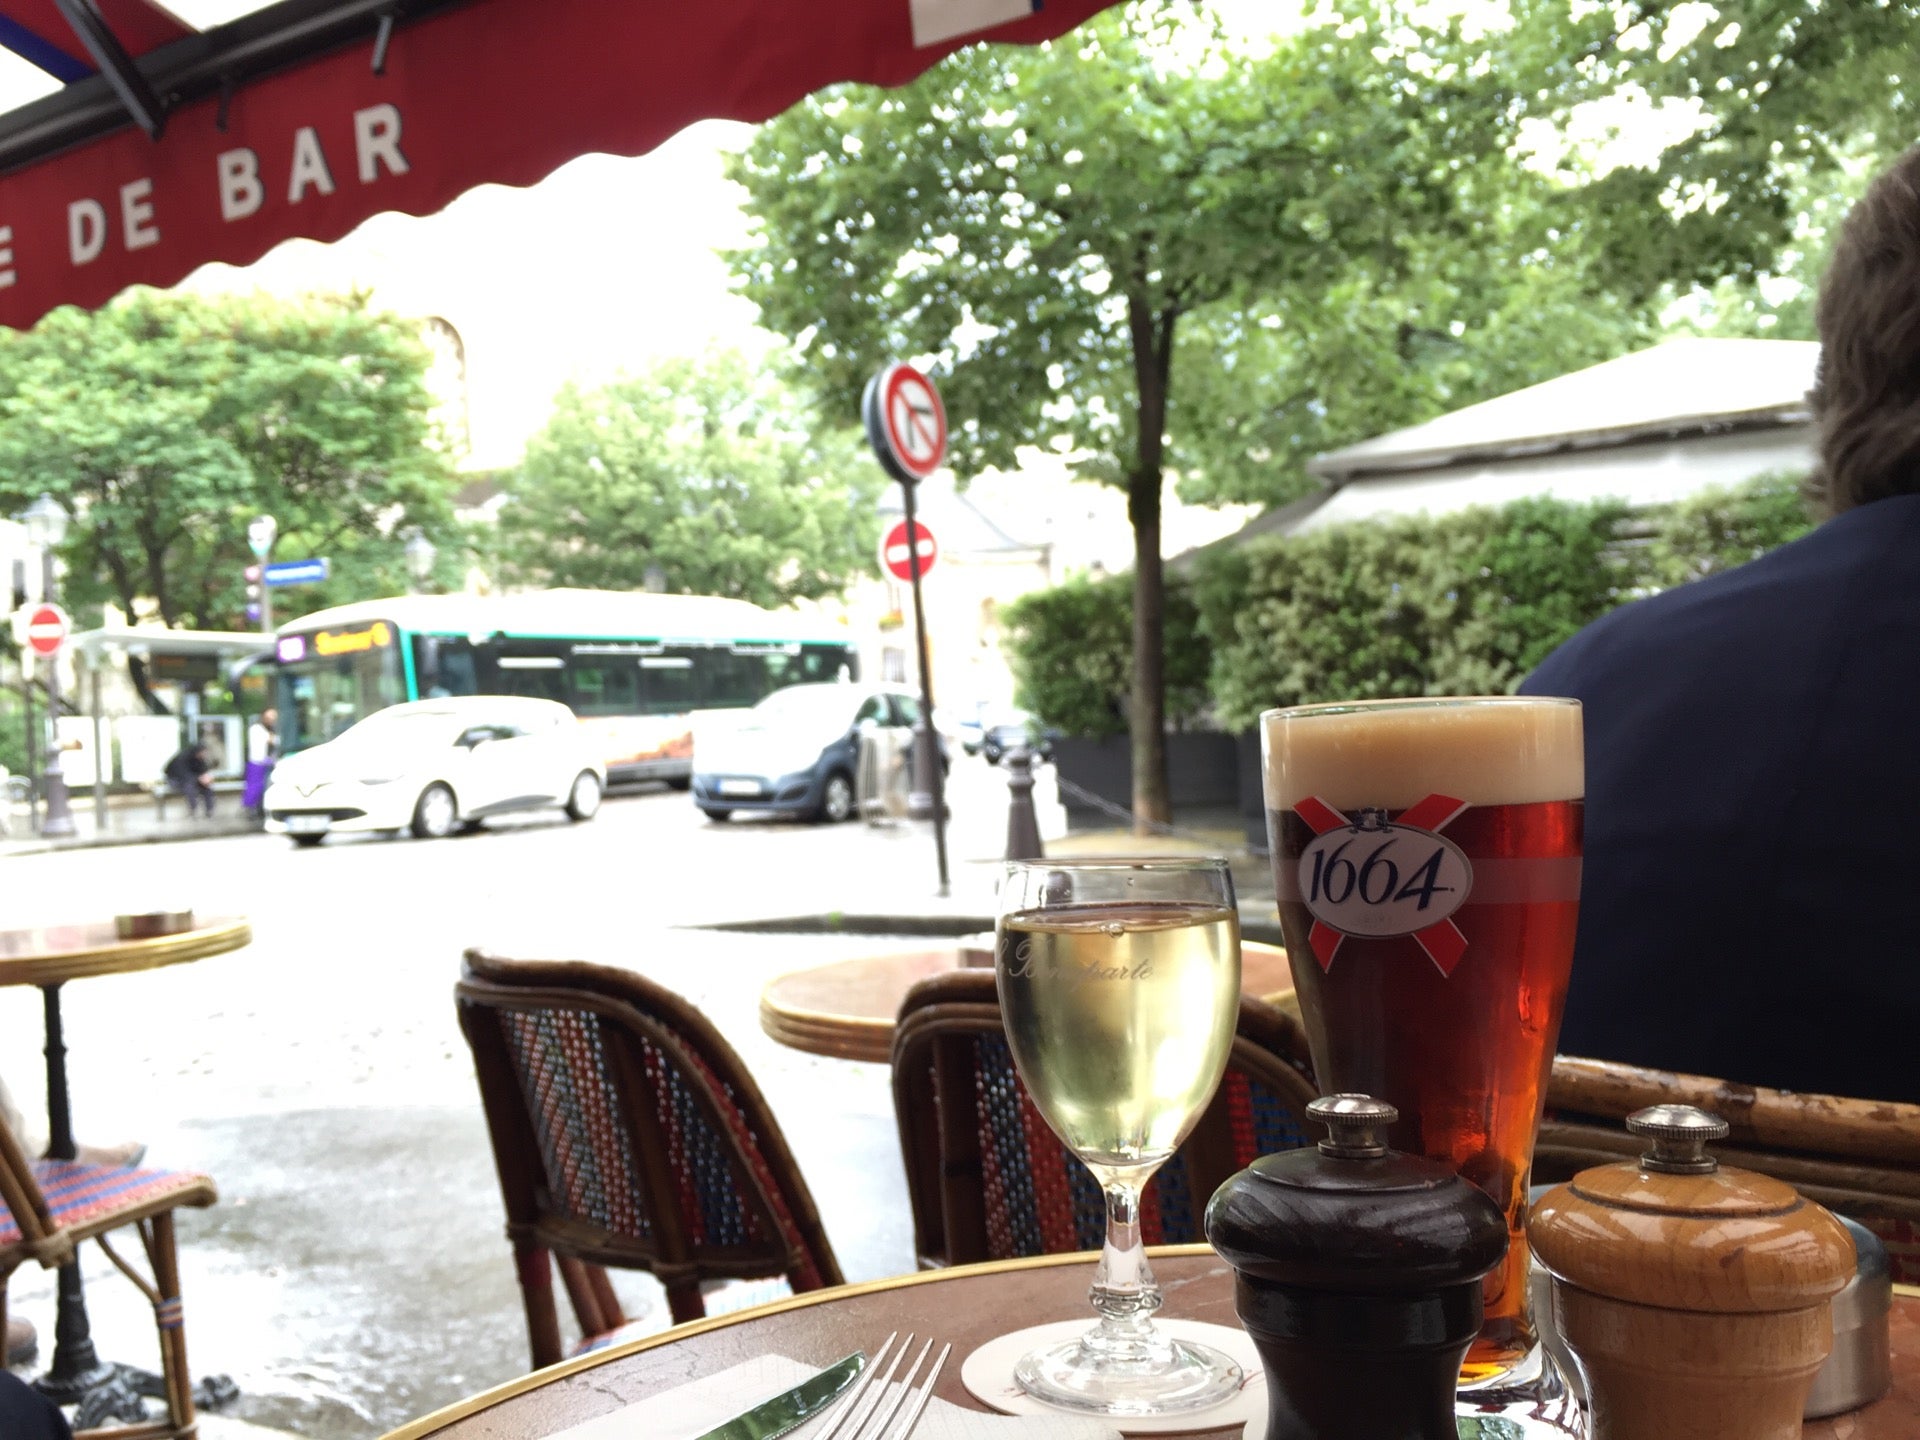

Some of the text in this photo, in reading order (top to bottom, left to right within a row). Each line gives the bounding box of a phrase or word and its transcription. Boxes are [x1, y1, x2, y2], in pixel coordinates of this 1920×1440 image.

[67, 178, 160, 266] DE
[217, 103, 410, 222] BAR
[1310, 837, 1451, 912] 1664
[1008, 938, 1153, 993] Bonparte
